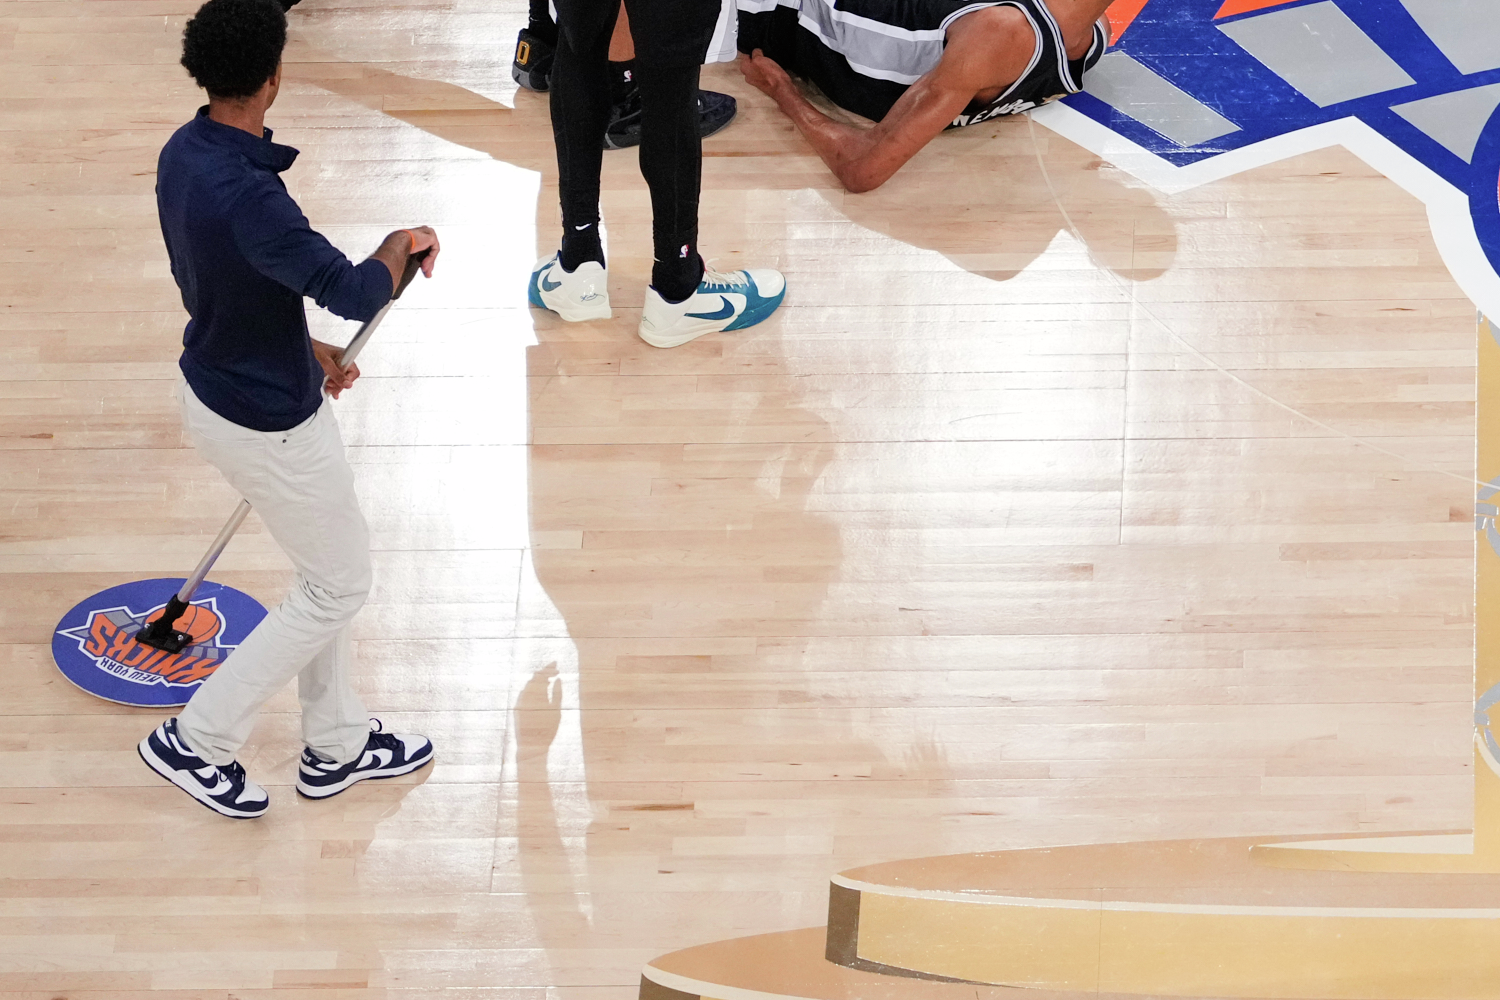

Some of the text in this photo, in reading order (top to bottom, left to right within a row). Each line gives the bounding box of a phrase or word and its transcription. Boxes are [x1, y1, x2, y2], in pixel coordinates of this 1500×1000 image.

[84, 613, 223, 683] KNICKS
[100, 657, 161, 683] NEW YORK
